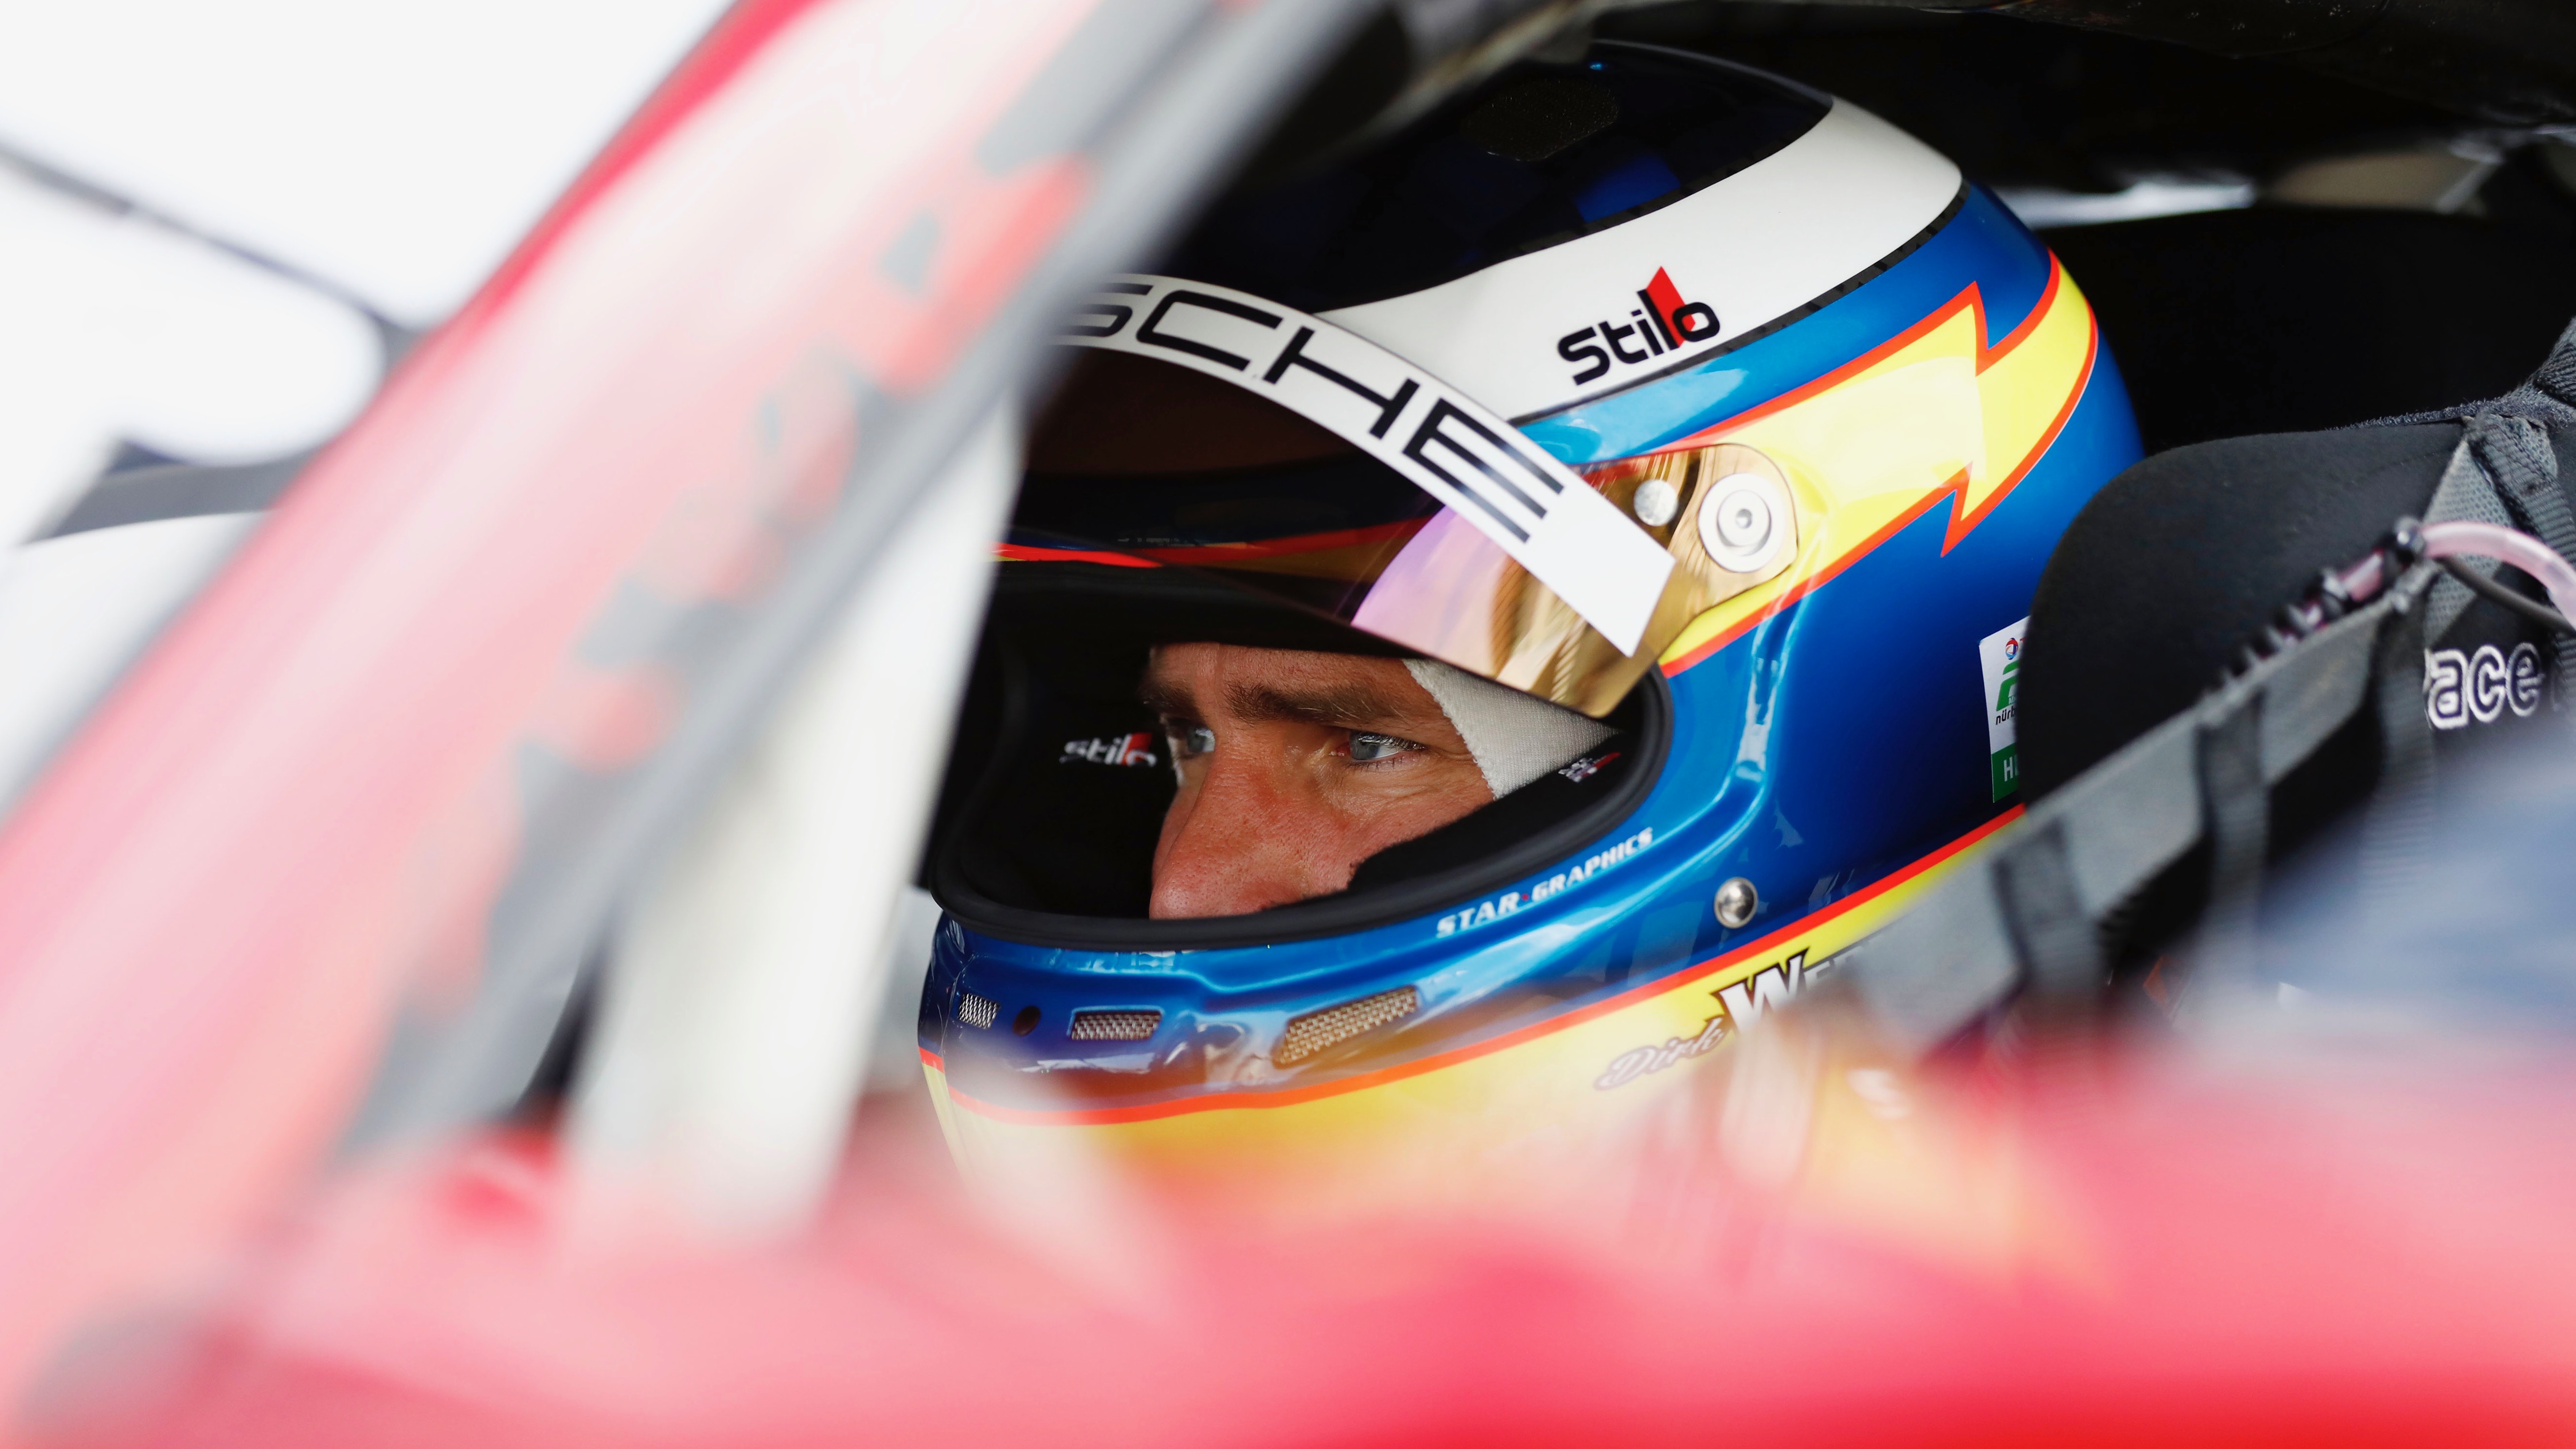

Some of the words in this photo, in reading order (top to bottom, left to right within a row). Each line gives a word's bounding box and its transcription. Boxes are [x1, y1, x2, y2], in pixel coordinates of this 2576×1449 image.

[1557, 288, 1720, 386] Stilo
[2423, 643, 2543, 729] ace
[1436, 891, 1521, 939] STAR
[1531, 826, 1653, 902] GRAPHICS
[1594, 1016, 1728, 1090] Dirk
